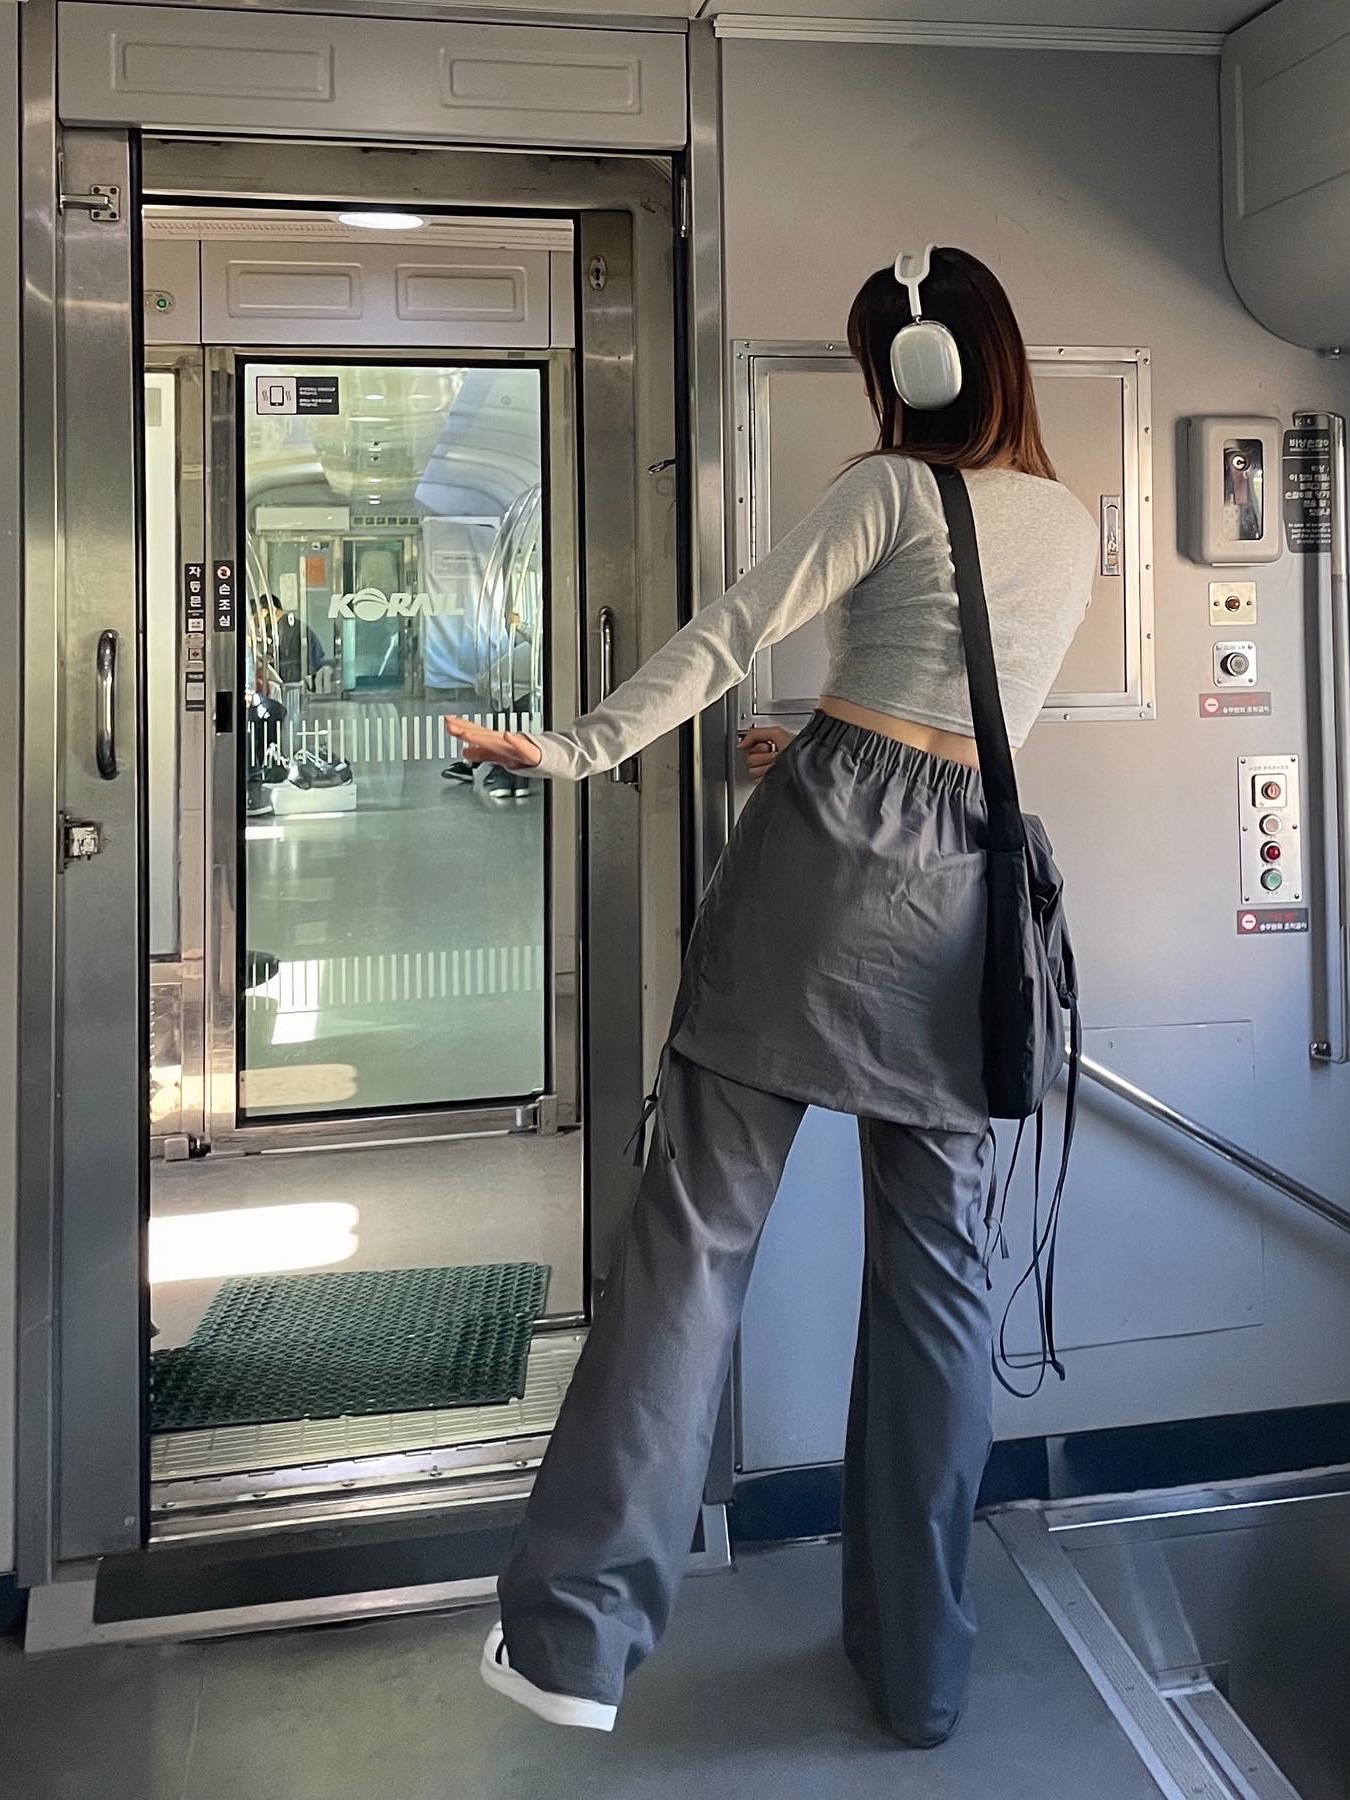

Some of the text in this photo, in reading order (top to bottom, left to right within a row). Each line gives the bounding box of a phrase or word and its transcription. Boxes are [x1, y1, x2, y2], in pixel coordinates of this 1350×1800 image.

[188, 566, 202, 608] 자동문
[218, 583, 231, 627] 손조심
[327, 587, 465, 622] KORAIL
